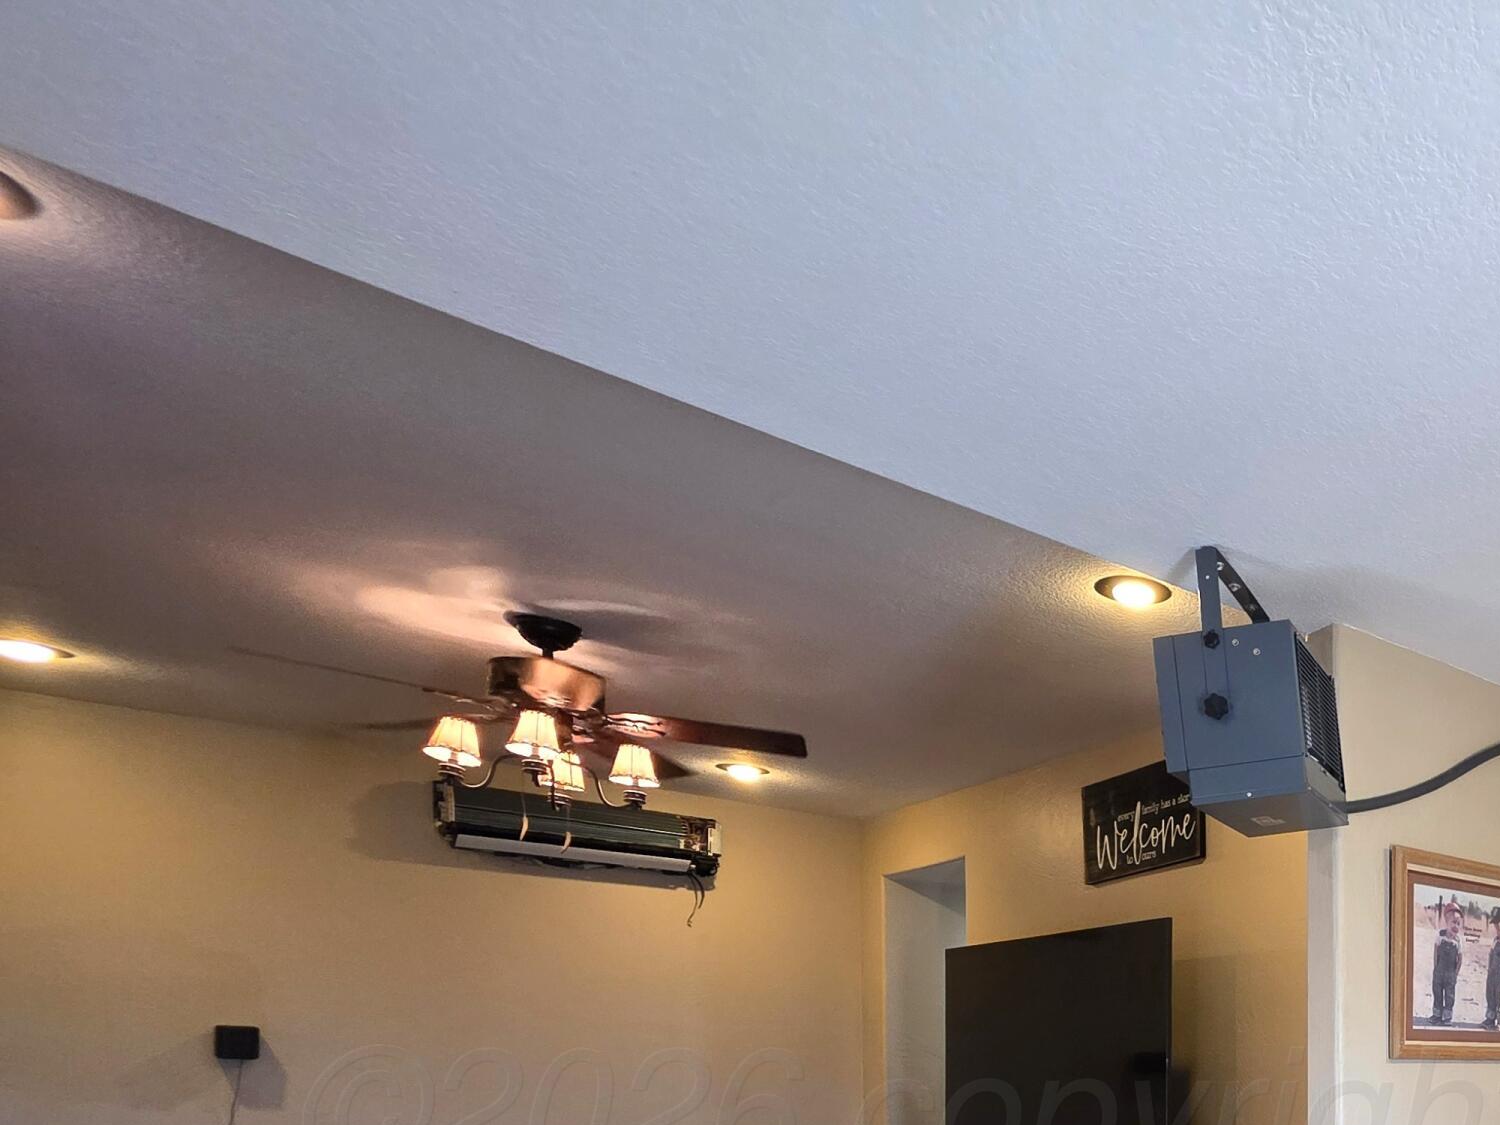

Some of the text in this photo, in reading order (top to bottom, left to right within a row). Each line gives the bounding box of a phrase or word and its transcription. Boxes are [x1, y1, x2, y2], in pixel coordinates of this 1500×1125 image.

[1142, 802, 1160, 814] family
[1160, 800, 1171, 809] has
[1172, 798, 1176, 806] a
[1177, 793, 1190, 804] stor
[1097, 800, 1196, 870] Welcome
[1126, 855, 1134, 864] to
